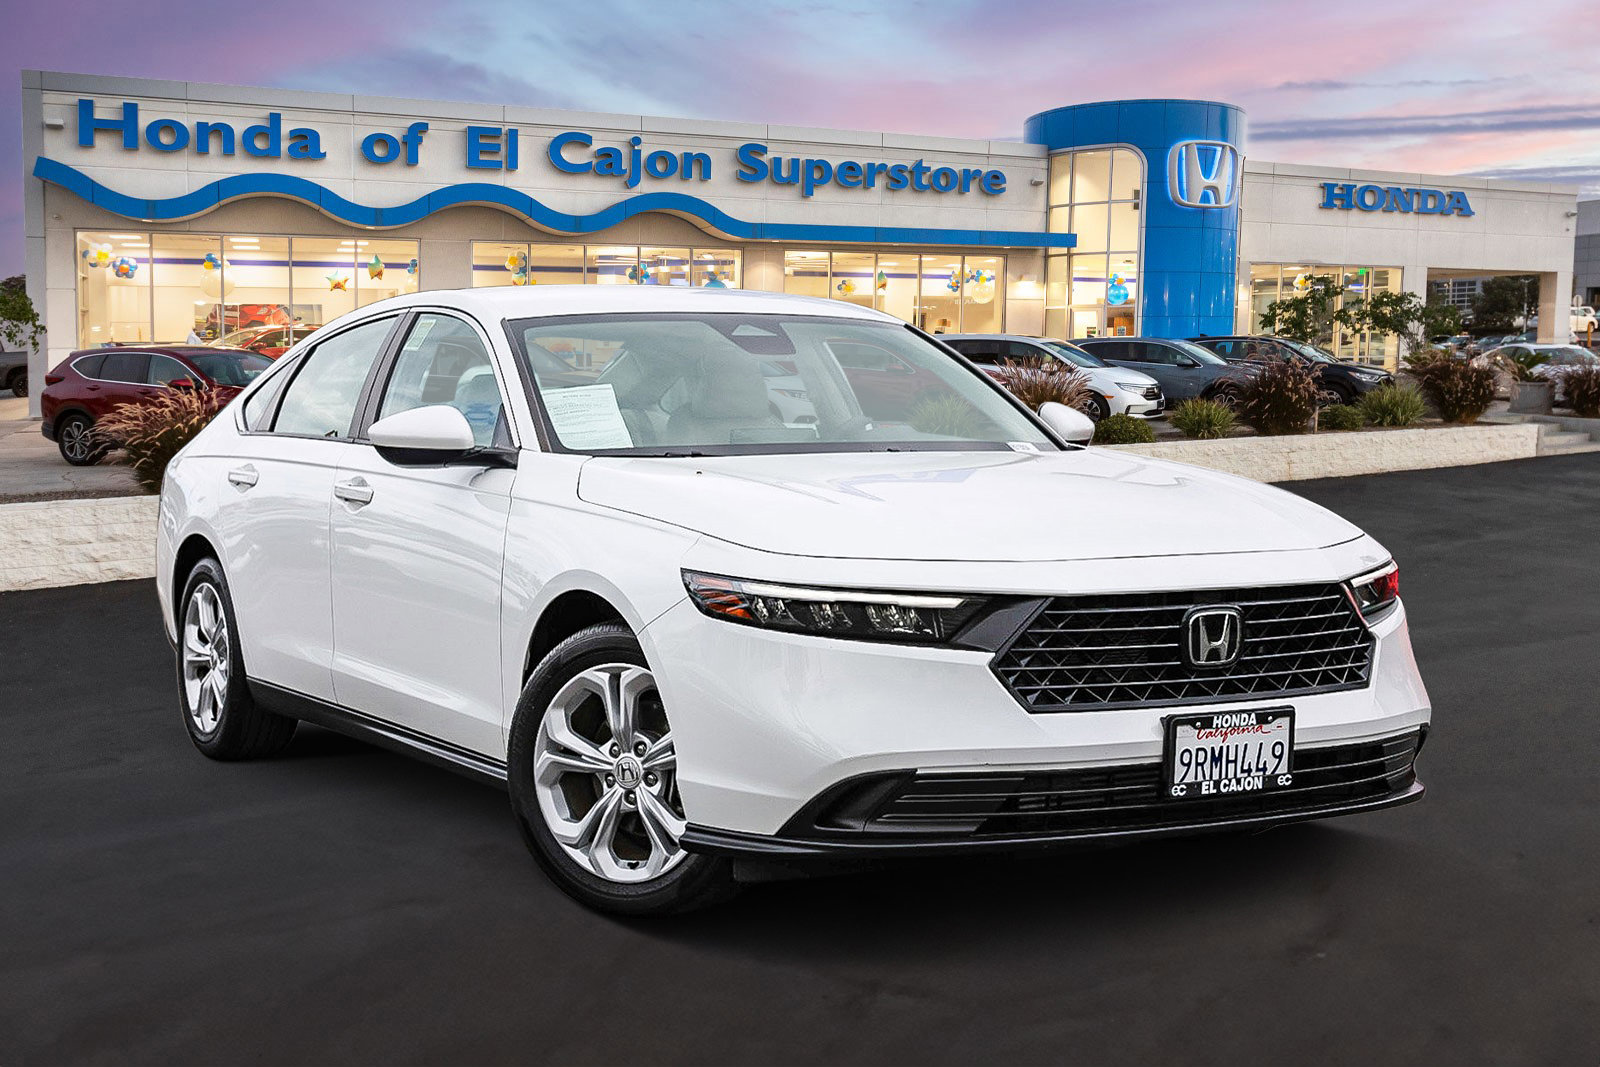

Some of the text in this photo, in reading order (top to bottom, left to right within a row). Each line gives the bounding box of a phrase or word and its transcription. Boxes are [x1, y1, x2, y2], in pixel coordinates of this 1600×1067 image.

[78, 98, 1007, 198] Honda of El Cajon Superstore
[1319, 182, 1475, 216] HONDA
[1196, 724, 1271, 743] California
[1212, 713, 1257, 728] HONDA
[1180, 741, 1284, 783] 9RMH449
[1201, 776, 1263, 795] EL CAJON
